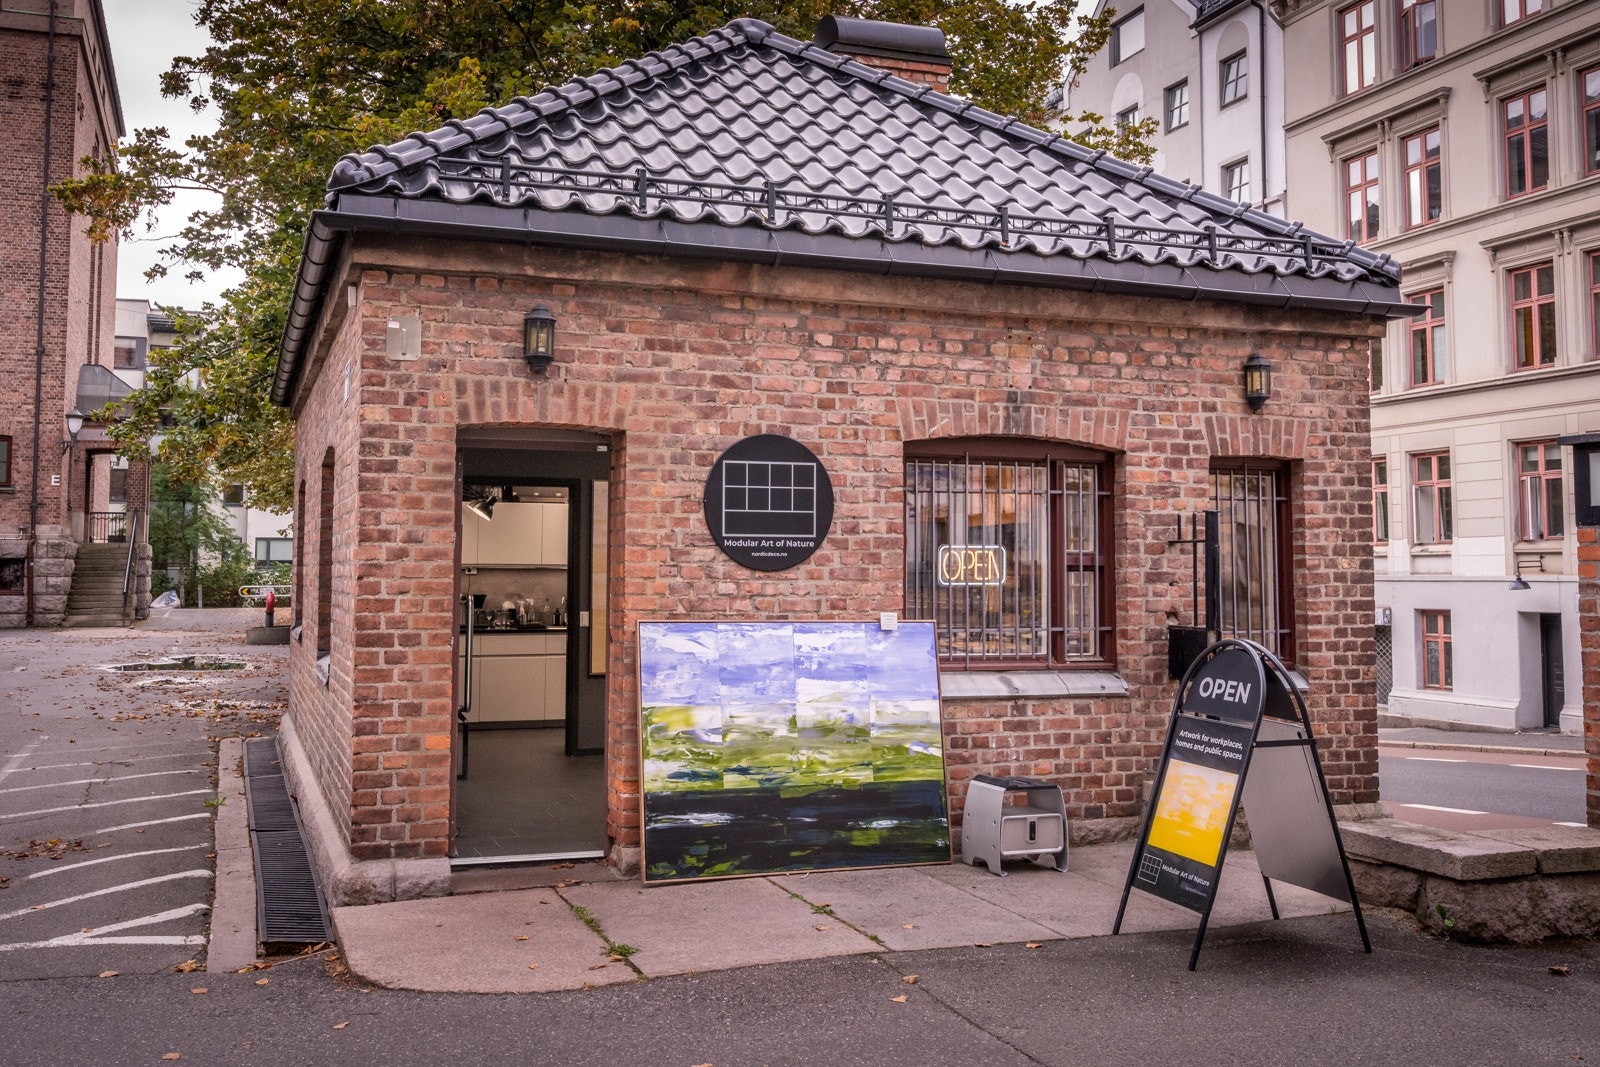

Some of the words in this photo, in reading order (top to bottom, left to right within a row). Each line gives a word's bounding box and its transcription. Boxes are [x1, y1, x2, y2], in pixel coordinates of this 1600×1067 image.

[51, 474, 61, 486] E
[724, 539, 759, 547] Modular
[760, 539, 774, 547] Art
[775, 539, 785, 548] of
[786, 540, 815, 548] Nature
[942, 550, 1001, 581] OPEN
[1199, 676, 1252, 704] OPEN
[1174, 738, 1193, 749] homes
[1193, 742, 1204, 752] and
[1204, 744, 1222, 756] public
[1222, 749, 1243, 761] spaces
[1179, 729, 1201, 741] Artwork
[1201, 733, 1210, 742] for
[1210, 736, 1244, 751] workplaces,
[1162, 864, 1180, 876] Modular
[1180, 871, 1188, 879] Art
[1194, 875, 1210, 887] Nature
